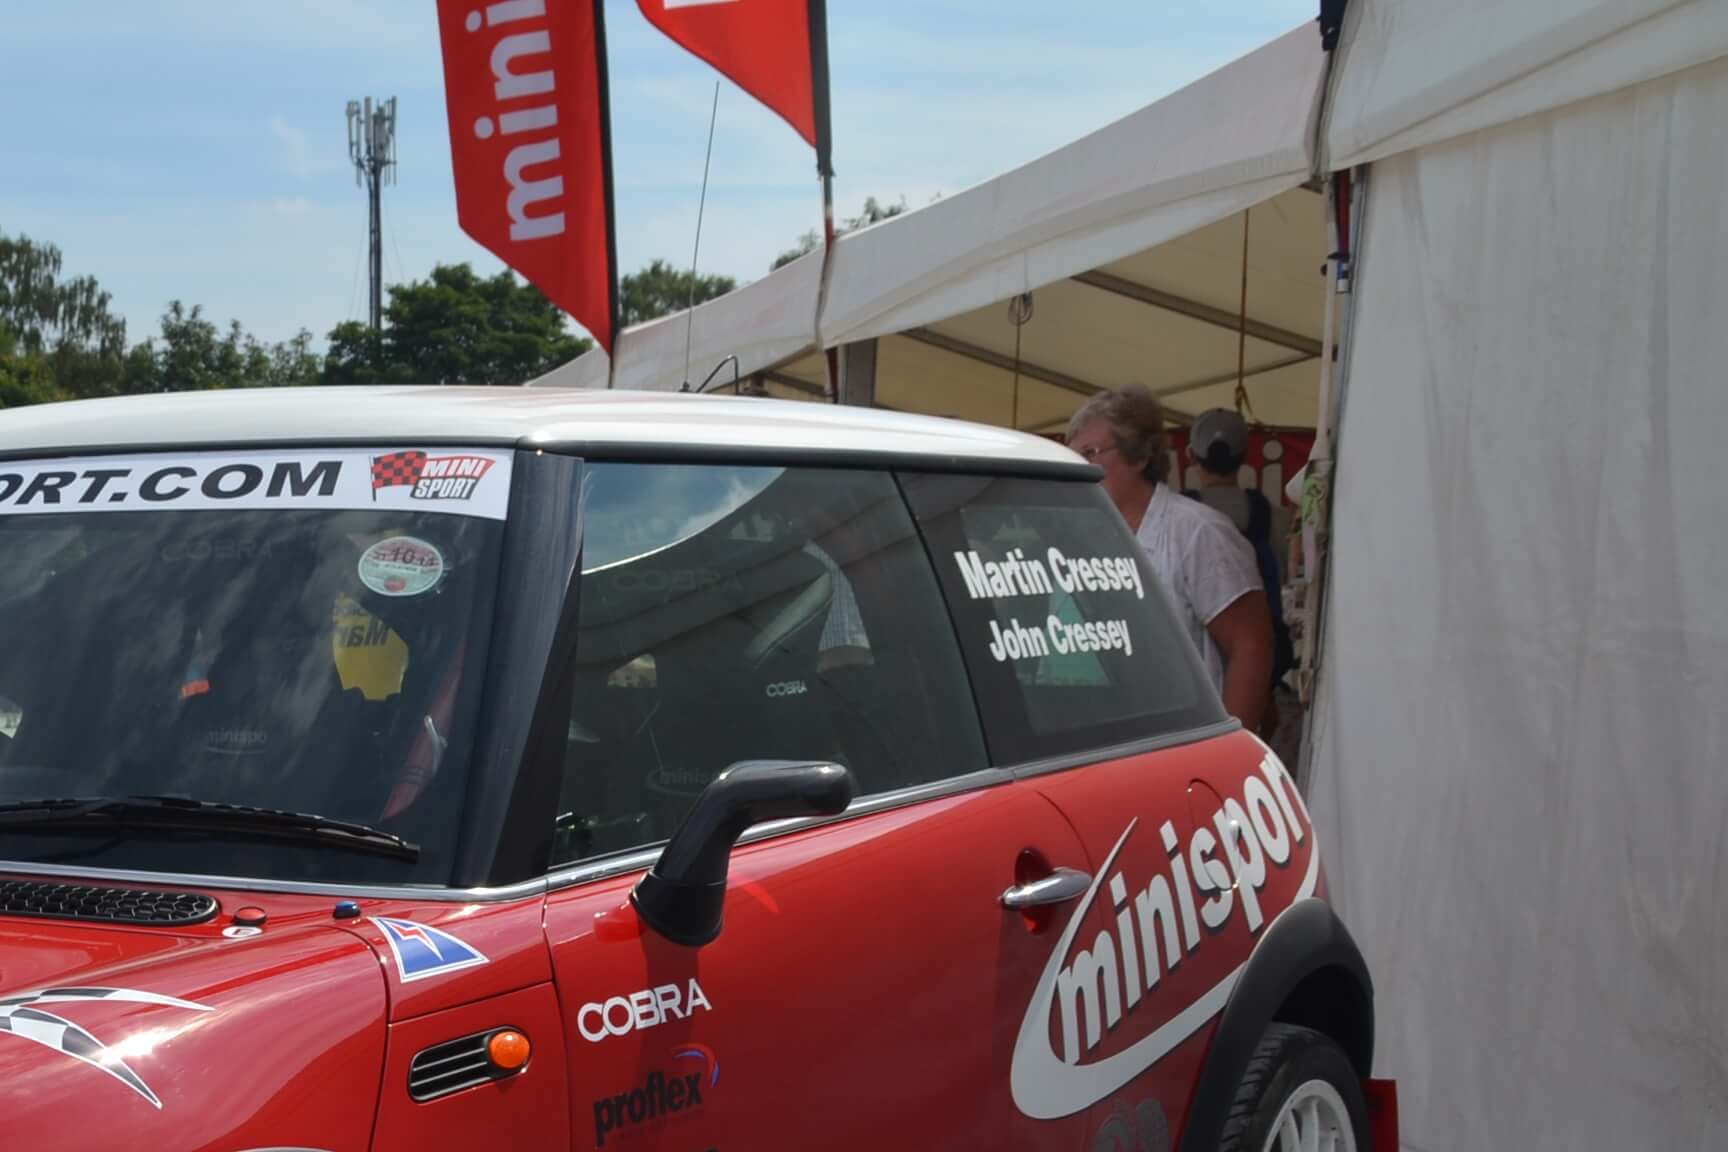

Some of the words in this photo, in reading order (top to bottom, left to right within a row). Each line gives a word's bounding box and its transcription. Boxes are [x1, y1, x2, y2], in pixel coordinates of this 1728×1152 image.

[414, 477, 477, 498] SPORT
[423, 458, 486, 478] MINI
[954, 548, 1053, 599] Martin
[1047, 546, 1144, 600] Cressey
[989, 618, 1050, 662] John
[1047, 614, 1133, 657] Cressey
[766, 680, 808, 697] COBRA
[577, 978, 712, 1042] COBRA
[593, 1071, 703, 1147] proflex
